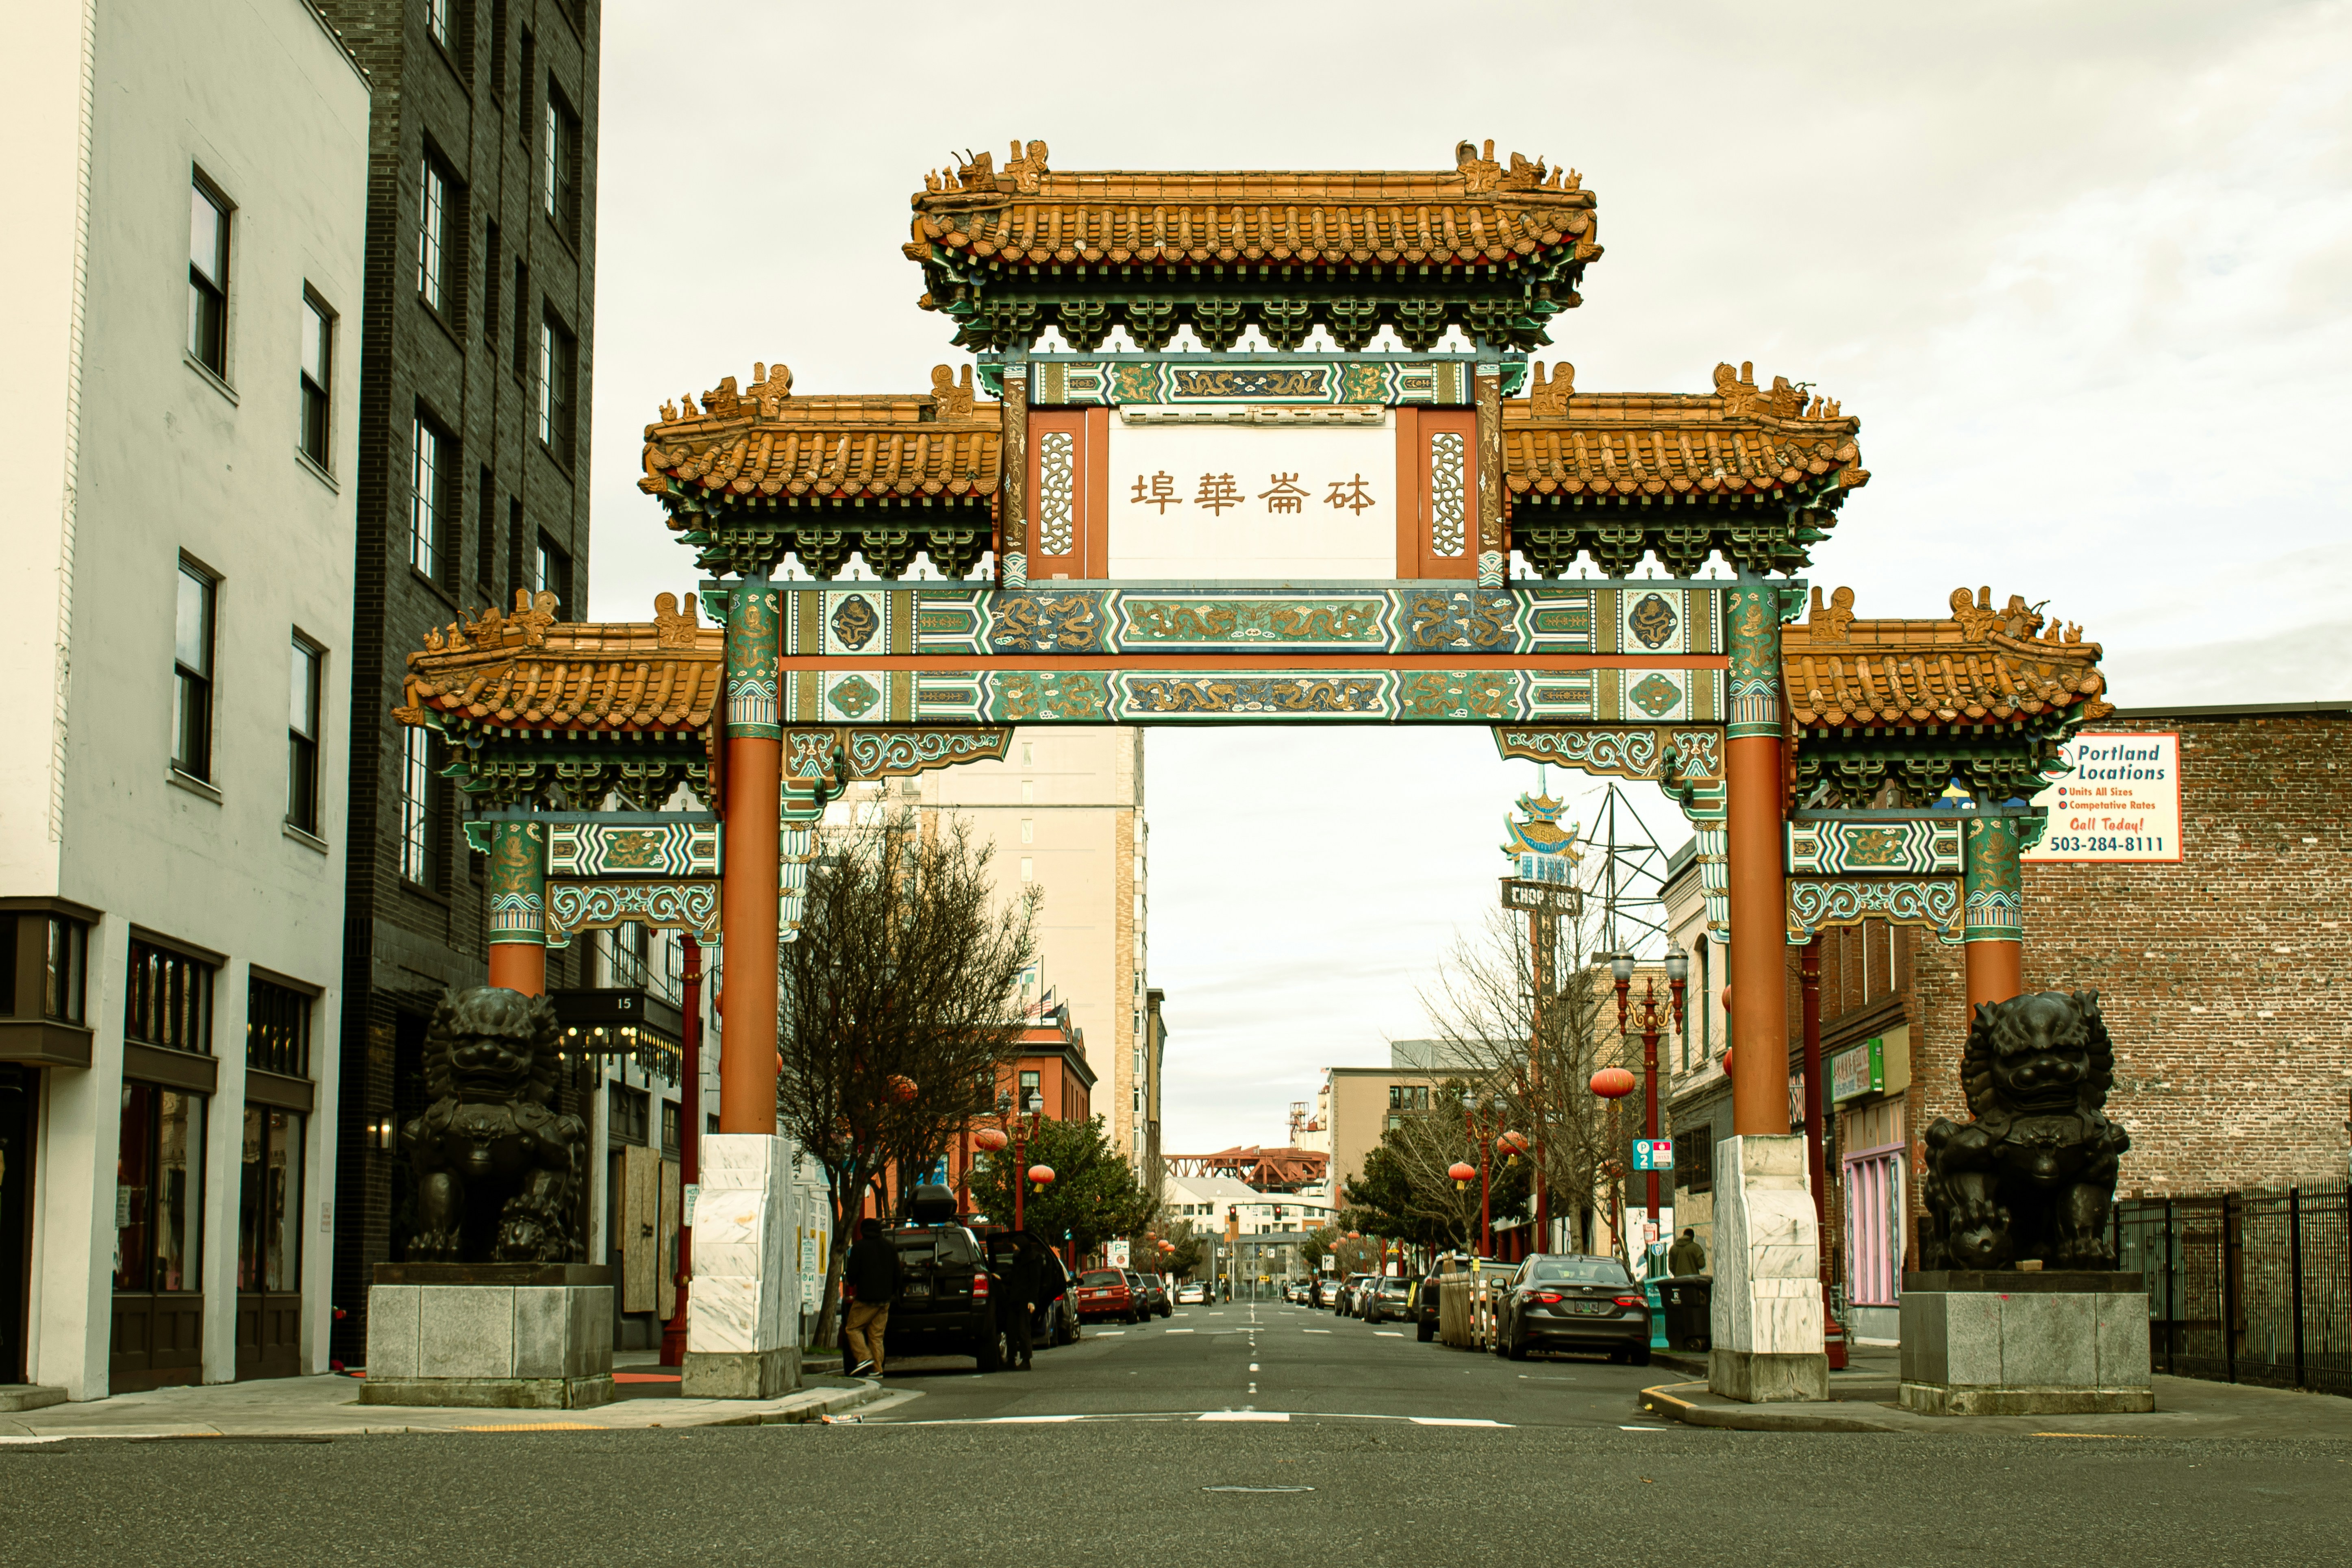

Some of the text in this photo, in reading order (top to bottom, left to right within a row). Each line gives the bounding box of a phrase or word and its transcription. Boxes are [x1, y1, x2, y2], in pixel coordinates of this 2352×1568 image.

[2078, 744, 2160, 761] Portland
[2078, 763, 2165, 780] Locations
[2069, 787, 2133, 796] Units All Sizes
[2069, 801, 2155, 811] Competative Rates
[2070, 818, 2144, 834] Call Today!
[2050, 837, 2163, 852] 503-284-8111
[1512, 887, 1544, 905] CHOP
[618, 998, 631, 1009] 15
[1640, 1155, 1648, 1166] 2
[1115, 1244, 1122, 1252] P
